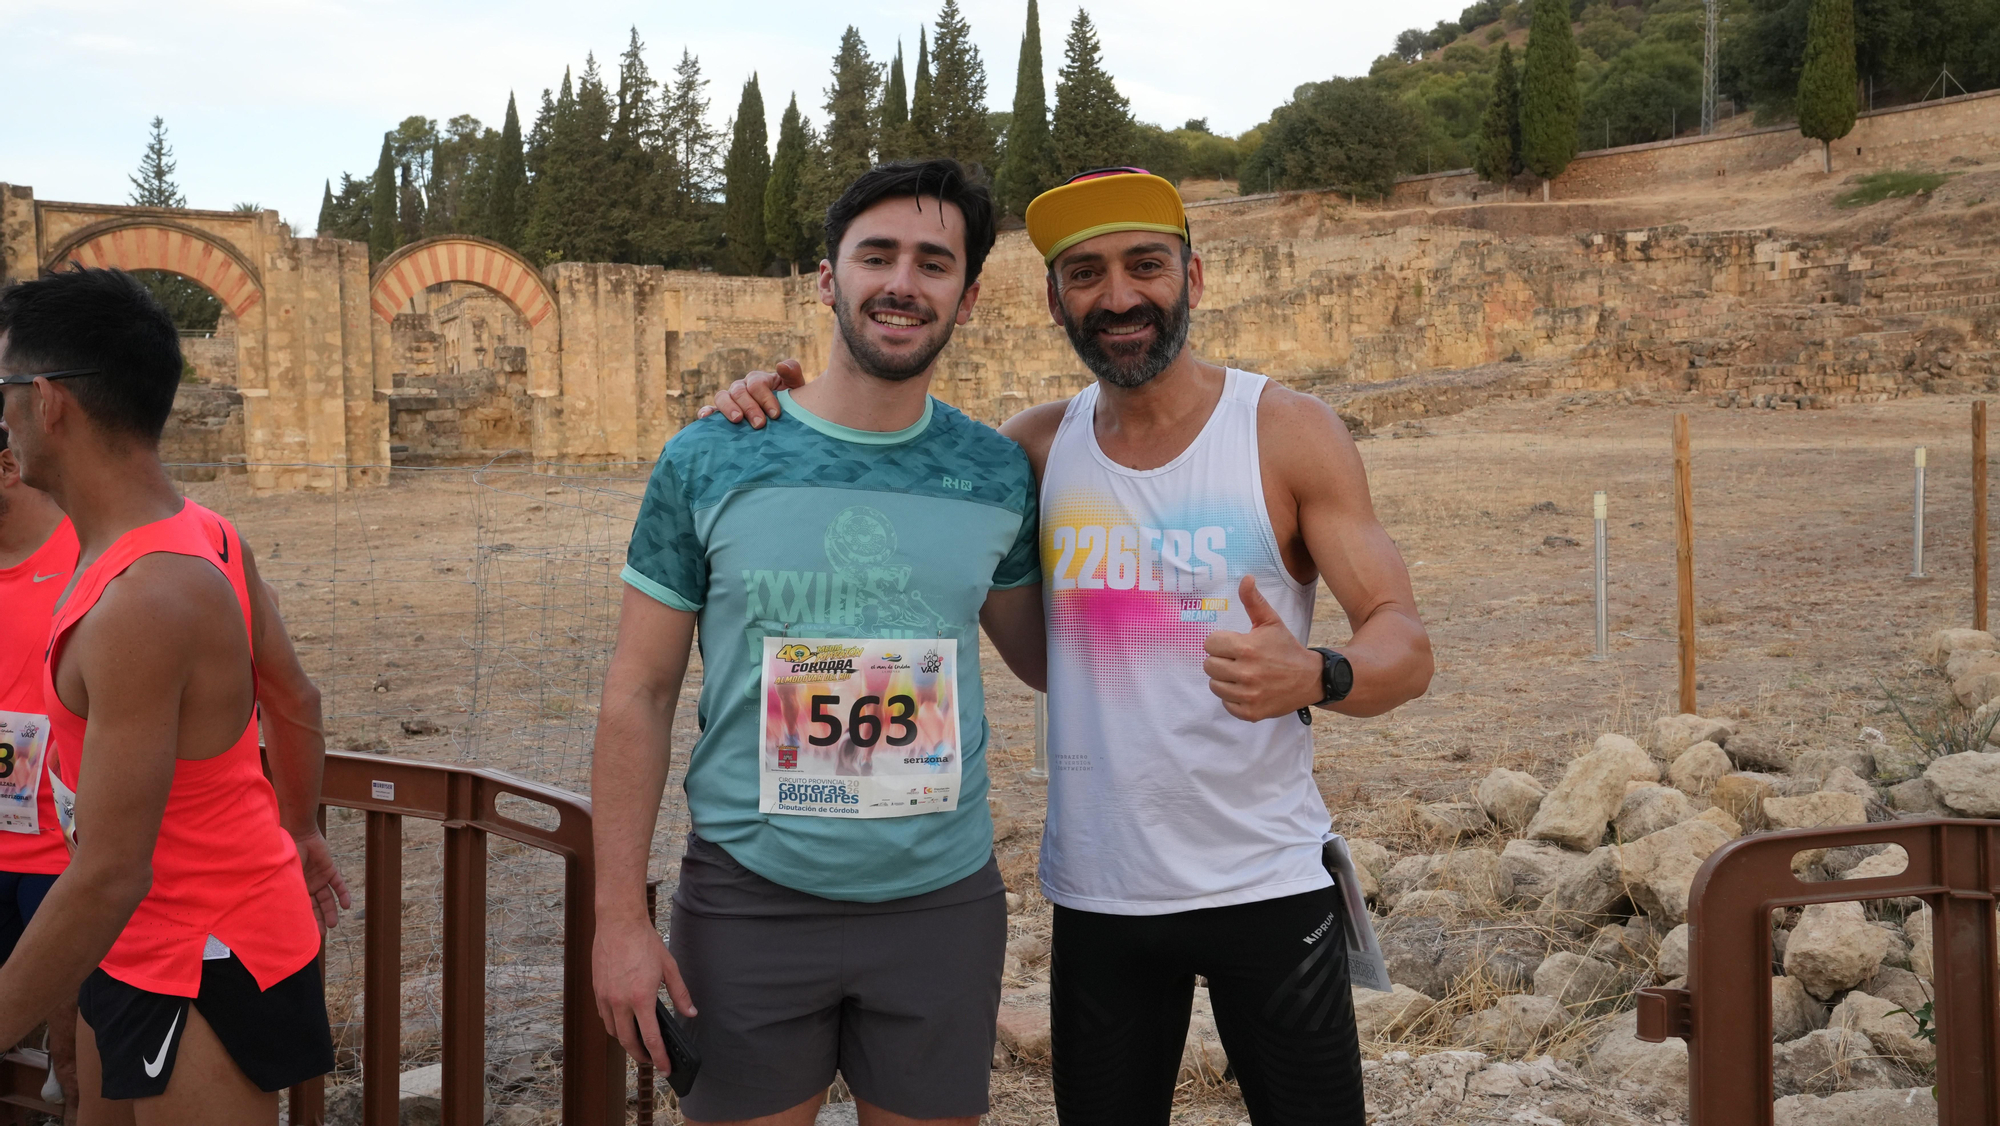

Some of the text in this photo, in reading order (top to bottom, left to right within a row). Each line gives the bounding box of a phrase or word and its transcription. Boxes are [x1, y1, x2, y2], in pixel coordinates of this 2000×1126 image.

[1182, 599, 1226, 610] FEED YOUR
[1181, 610, 1216, 621] DREAMS
[815, 646, 864, 662] MARATÓN
[817, 644, 843, 653] MEDIA
[808, 694, 918, 748] 563
[904, 756, 949, 764] serizona
[778, 777, 807, 785] CIRCUITO
[808, 778, 846, 786] PROVINCIAL
[778, 783, 847, 795] carreras
[778, 791, 859, 805] populares
[778, 803, 817, 812] Diputación
[1303, 912, 1335, 945] KIPRUN
